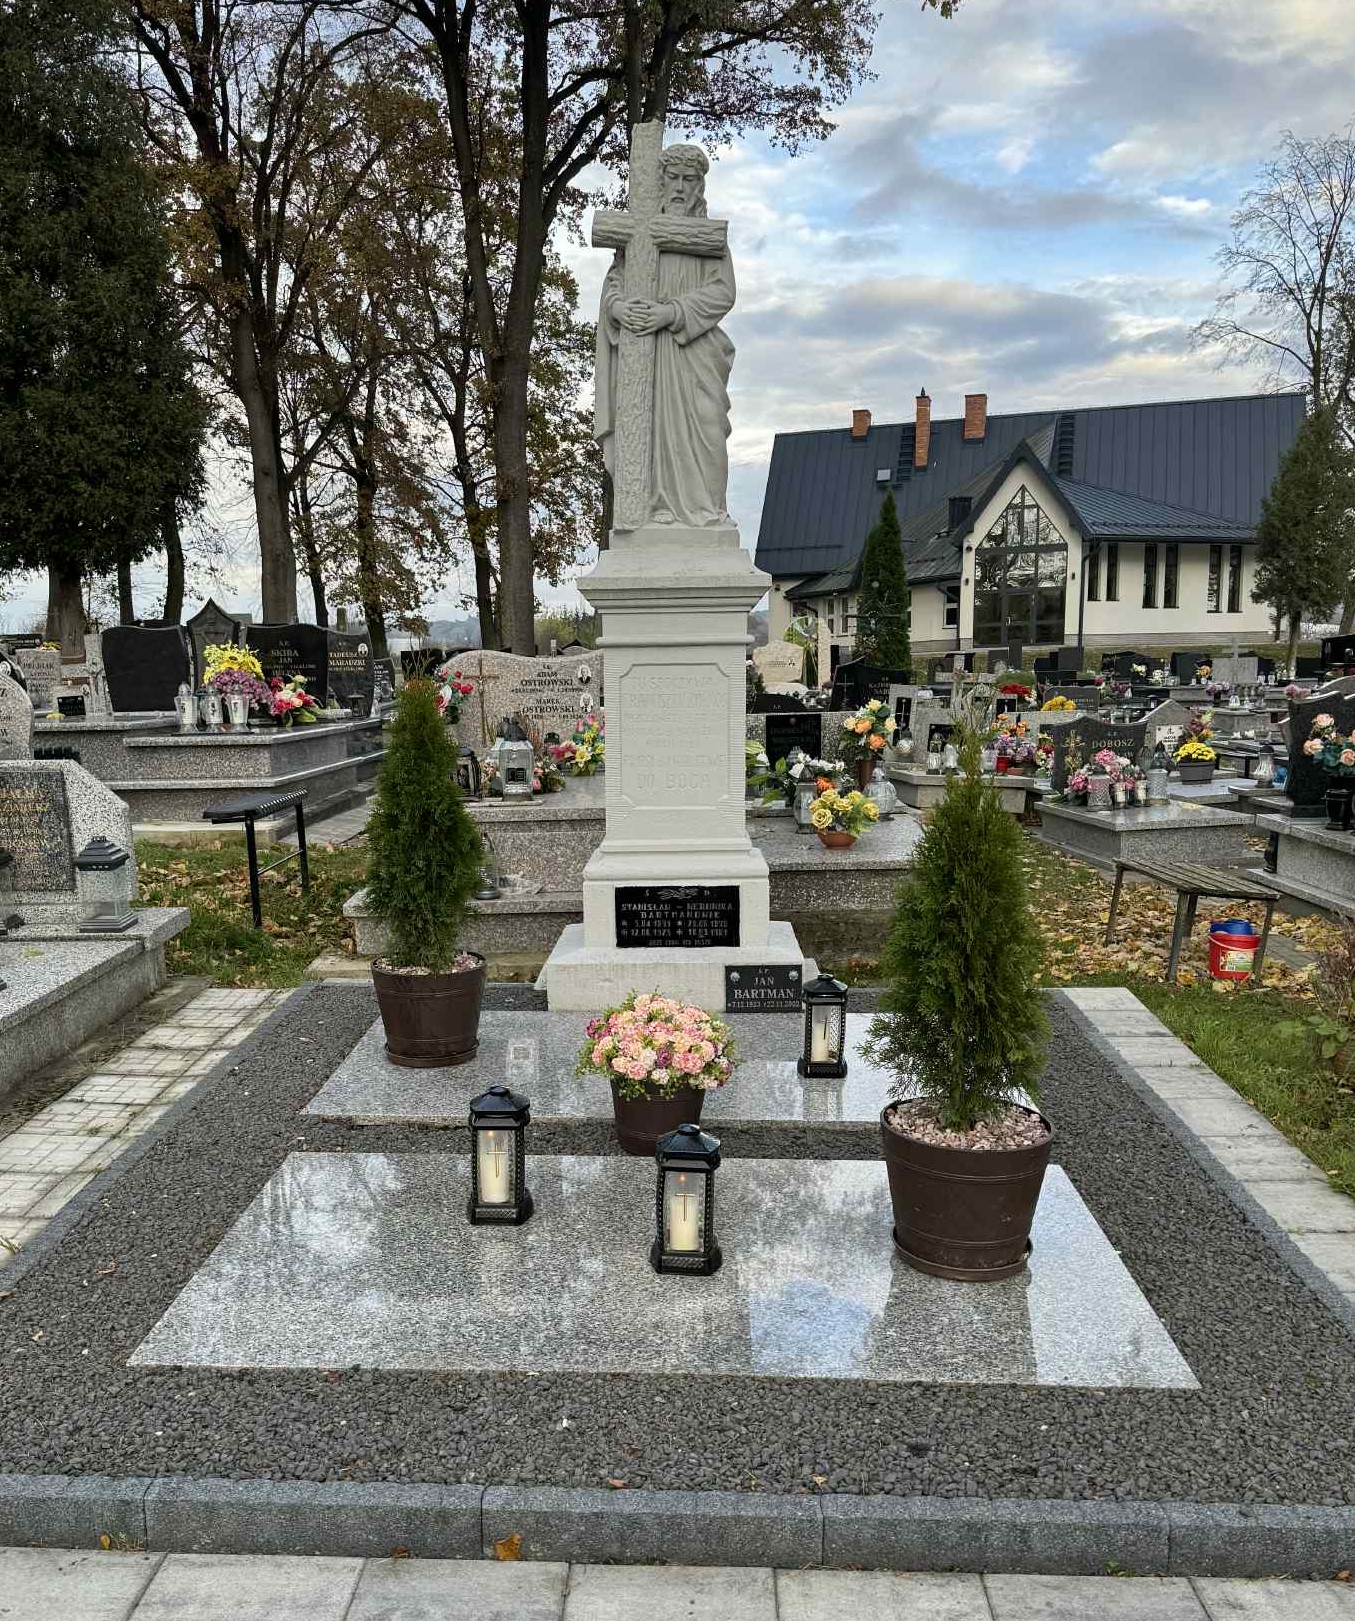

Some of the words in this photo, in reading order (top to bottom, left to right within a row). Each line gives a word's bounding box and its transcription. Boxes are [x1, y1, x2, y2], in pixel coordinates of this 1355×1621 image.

[520, 679, 573, 687] OSTROWSKI
[522, 705, 575, 714] OSTROWSKI
[1091, 738, 1135, 749] DOBOSZ
[754, 976, 775, 986] JAN
[733, 988, 794, 999] BARTMAN
